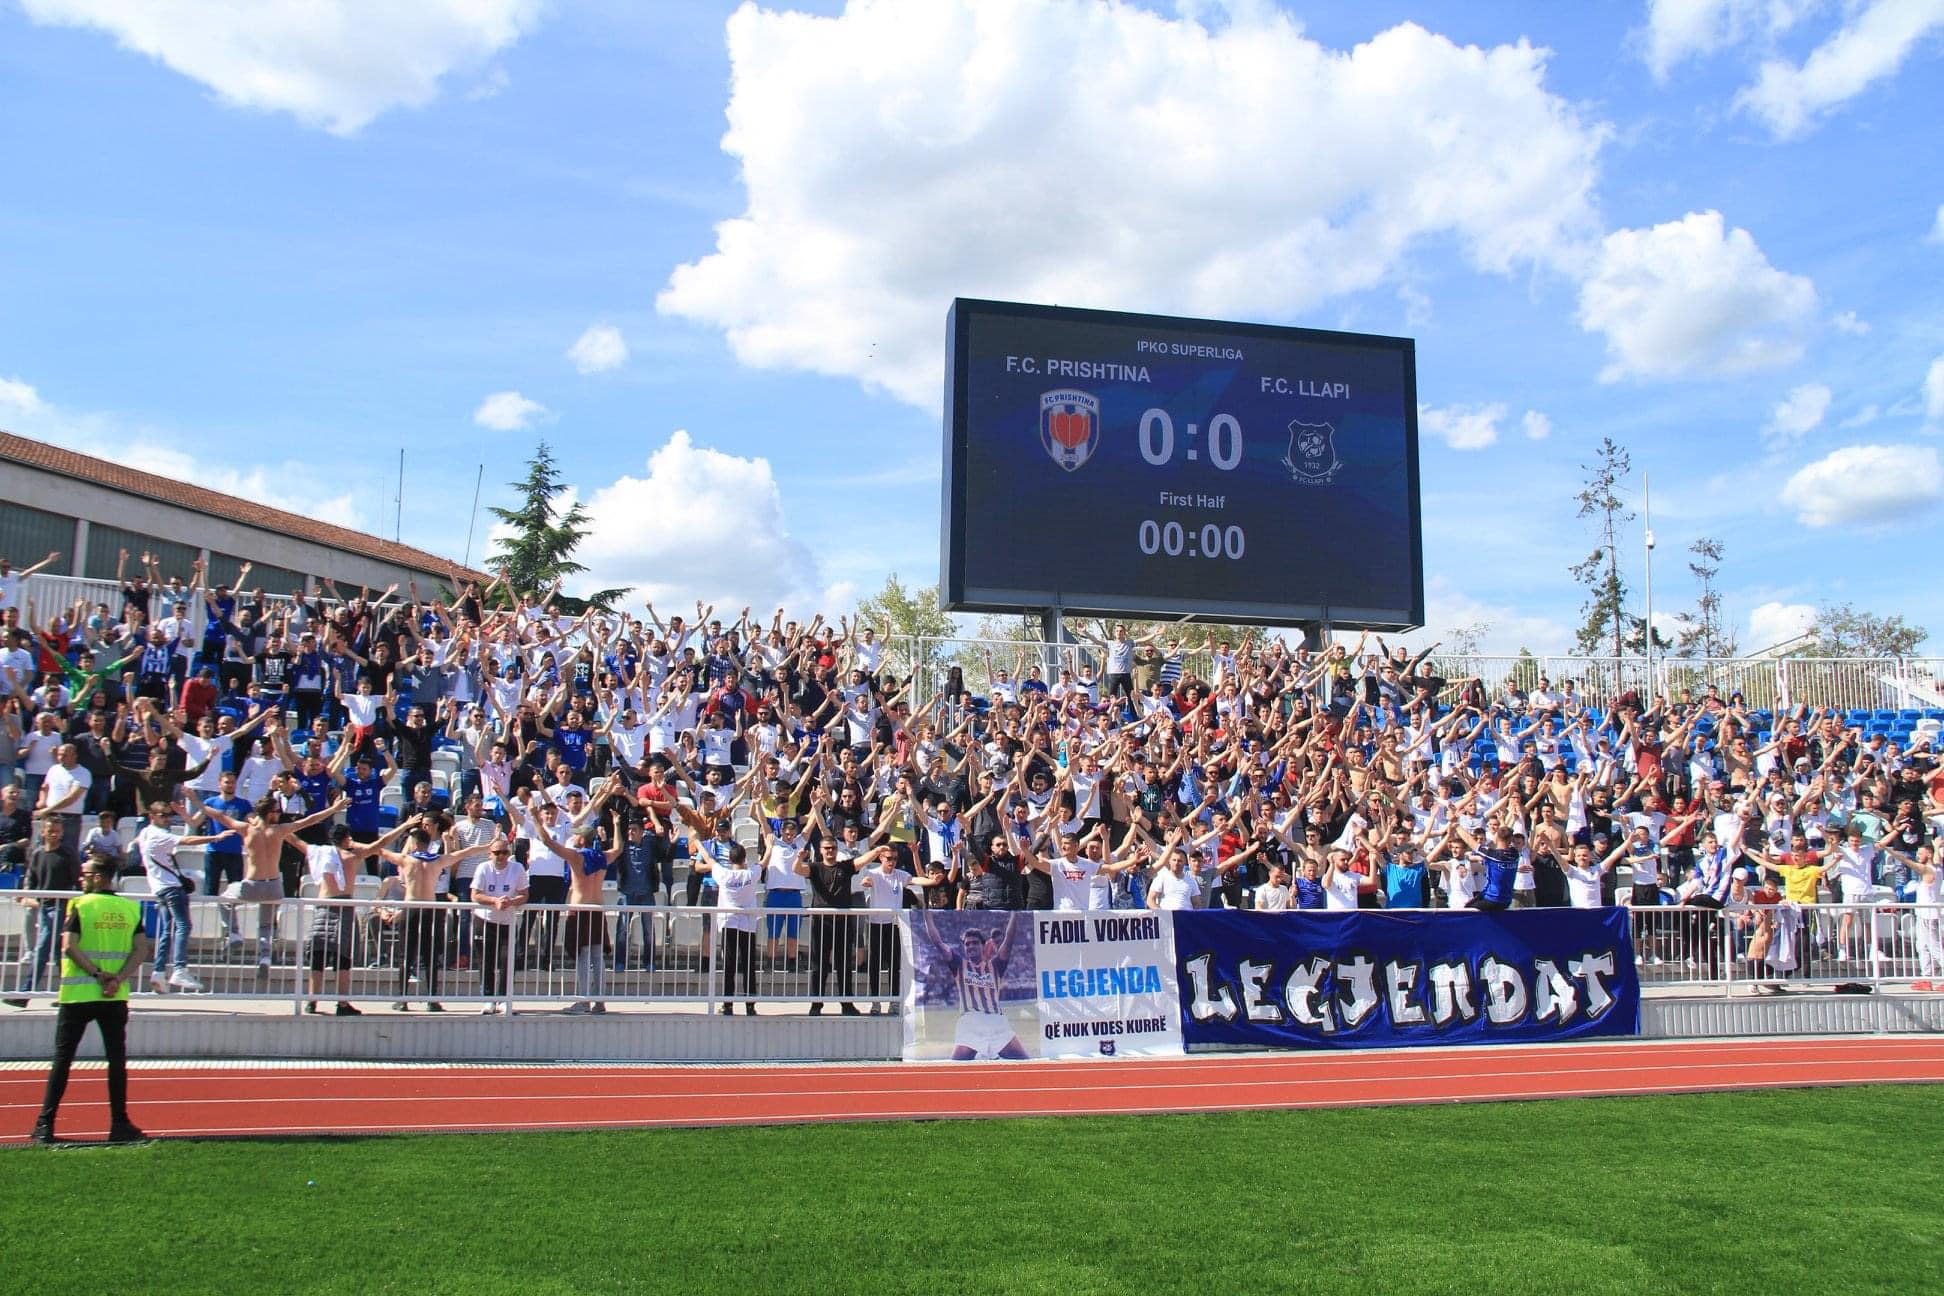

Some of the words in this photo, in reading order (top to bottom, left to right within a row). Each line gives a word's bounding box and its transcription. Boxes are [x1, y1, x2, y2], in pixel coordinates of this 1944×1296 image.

[1137, 341, 1168, 354] IPKO
[1171, 344, 1244, 361] SUPERLIGA
[1006, 356, 1040, 374] F.C.
[1047, 359, 1151, 383] PRISHTINA
[1261, 377, 1293, 394] F.C.
[1299, 380, 1350, 400] LLAPI
[1138, 408, 1243, 471] 0:0
[1160, 491, 1193, 507] First
[1197, 494, 1226, 509] Half
[1139, 519, 1246, 560] 00:00
[1039, 919, 1090, 945] FADIL
[1094, 916, 1161, 943] VOKRRI
[1041, 965, 1162, 999] LEGJENDA
[1045, 1022, 1061, 1040] QË
[1063, 1022, 1089, 1038] NUK
[1091, 1020, 1124, 1036] VDES
[1126, 1015, 1167, 1034] KURRË
